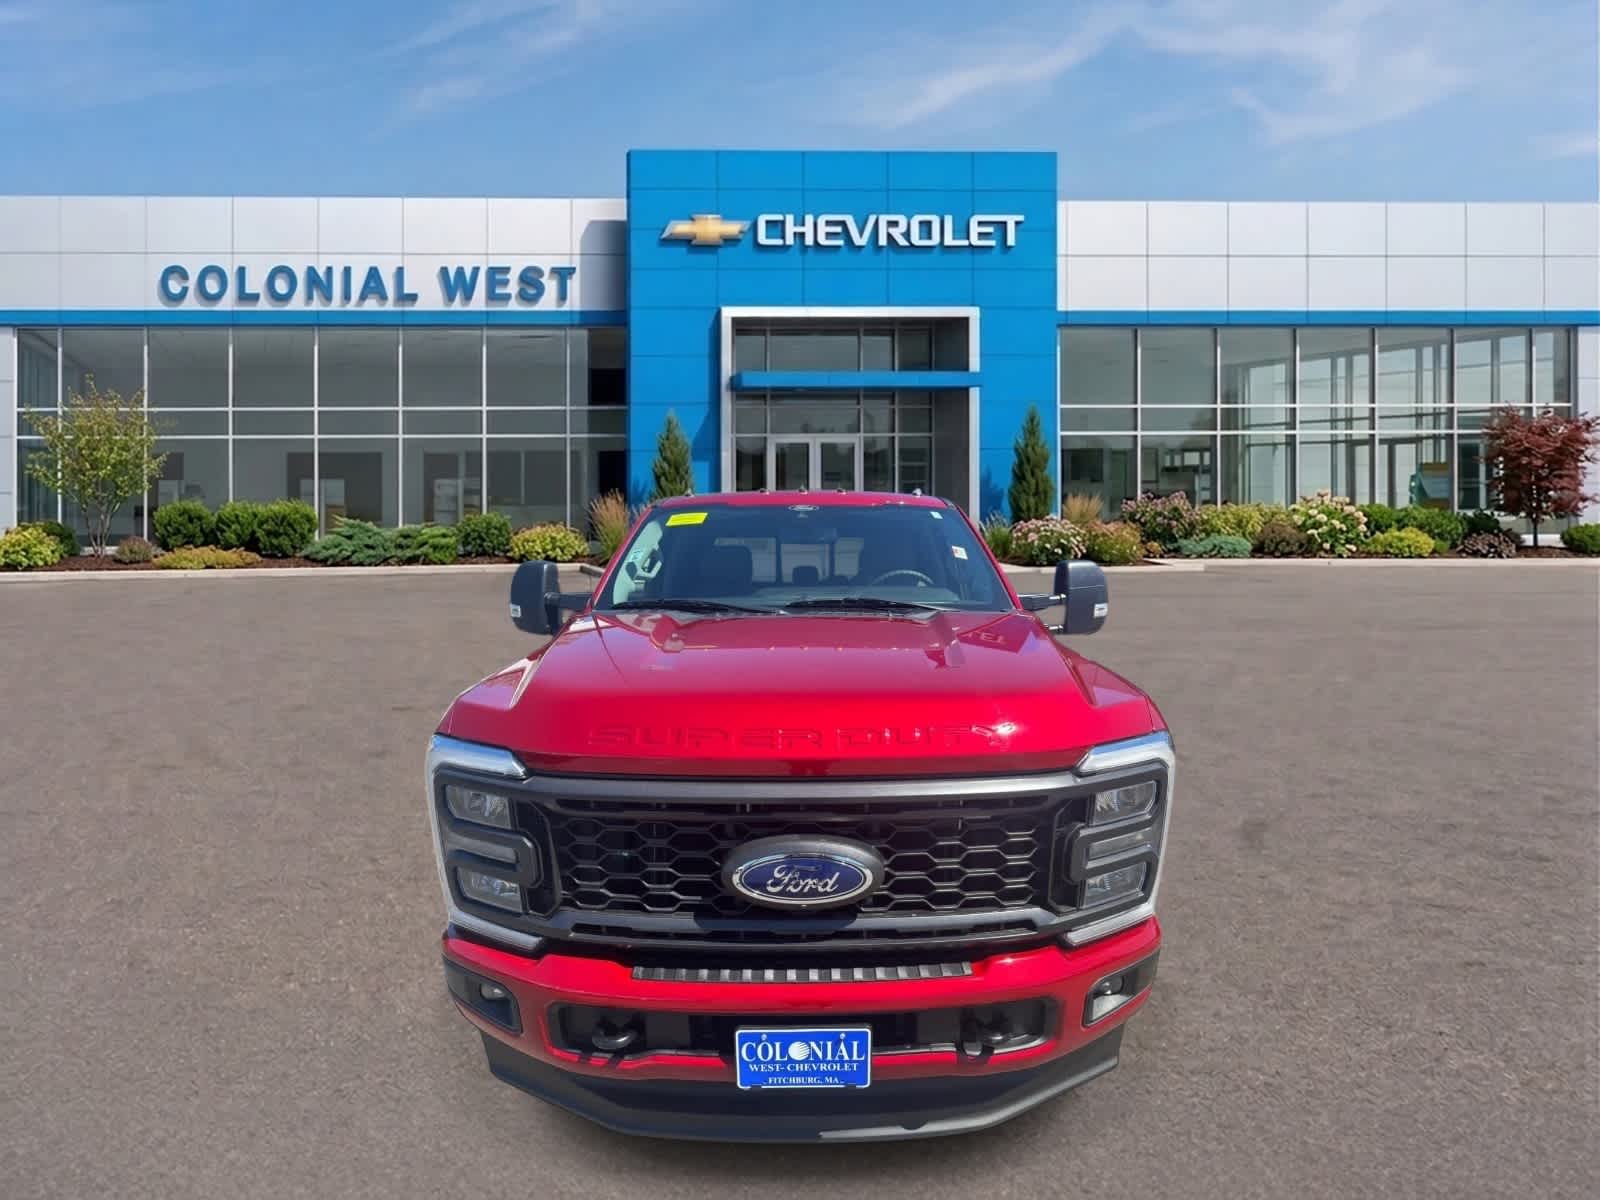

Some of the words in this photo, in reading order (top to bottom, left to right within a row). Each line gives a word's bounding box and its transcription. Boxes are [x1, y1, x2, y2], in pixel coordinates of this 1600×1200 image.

[756, 213, 1025, 247] CHEVROLET
[160, 264, 418, 306] COLONIAL
[438, 265, 577, 306] WEST
[588, 726, 823, 750] SUPER
[836, 722, 1018, 750] DUTY
[766, 864, 840, 893] Ford
[741, 1041, 865, 1062] COLONIAL
[787, 1062, 858, 1072] CHEVROLET
